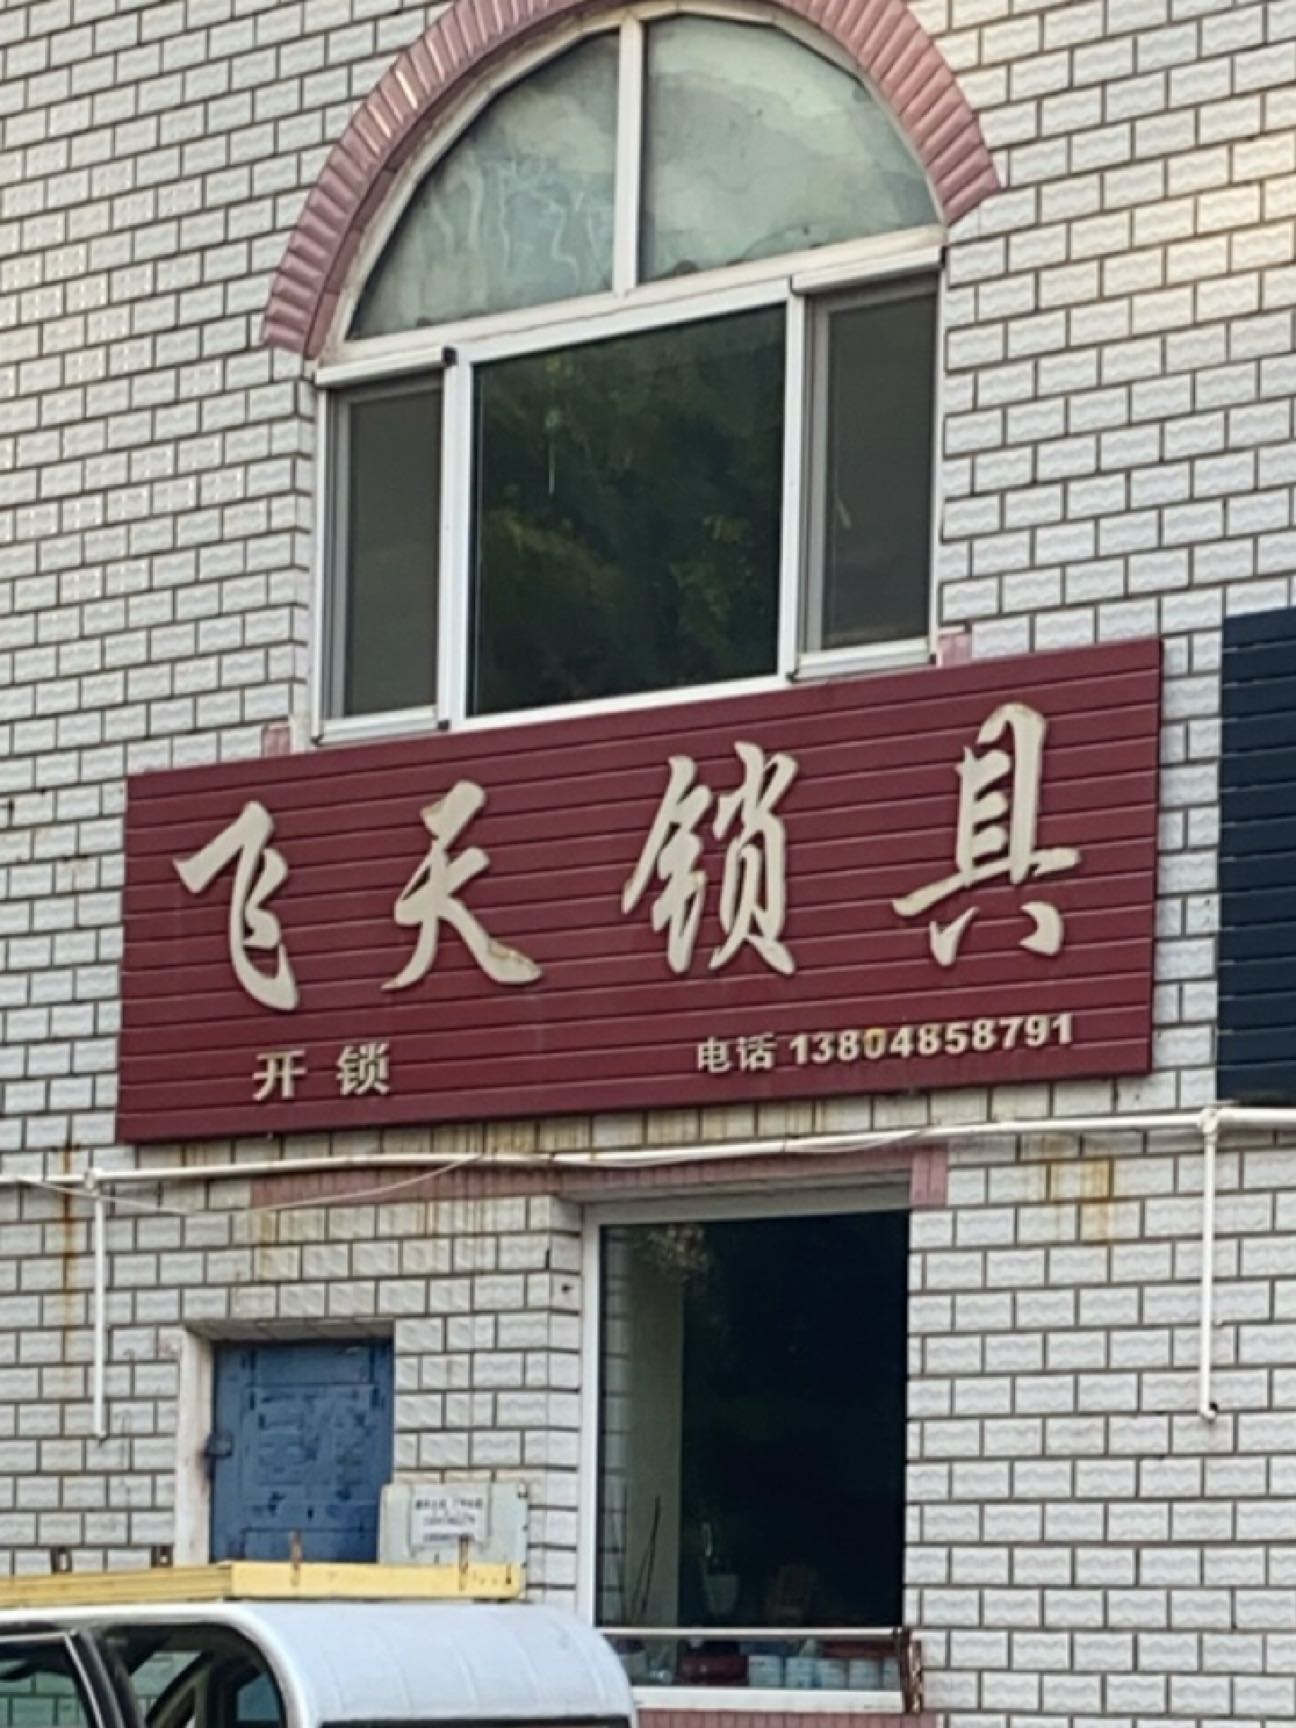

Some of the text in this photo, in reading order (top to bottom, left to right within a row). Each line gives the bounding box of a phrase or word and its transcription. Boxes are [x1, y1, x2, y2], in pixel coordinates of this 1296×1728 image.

[174, 702, 1080, 1011] 飞天锁具
[252, 1042, 389, 1100] 开锁
[697, 1012, 1073, 1073] 电话 13804858791
